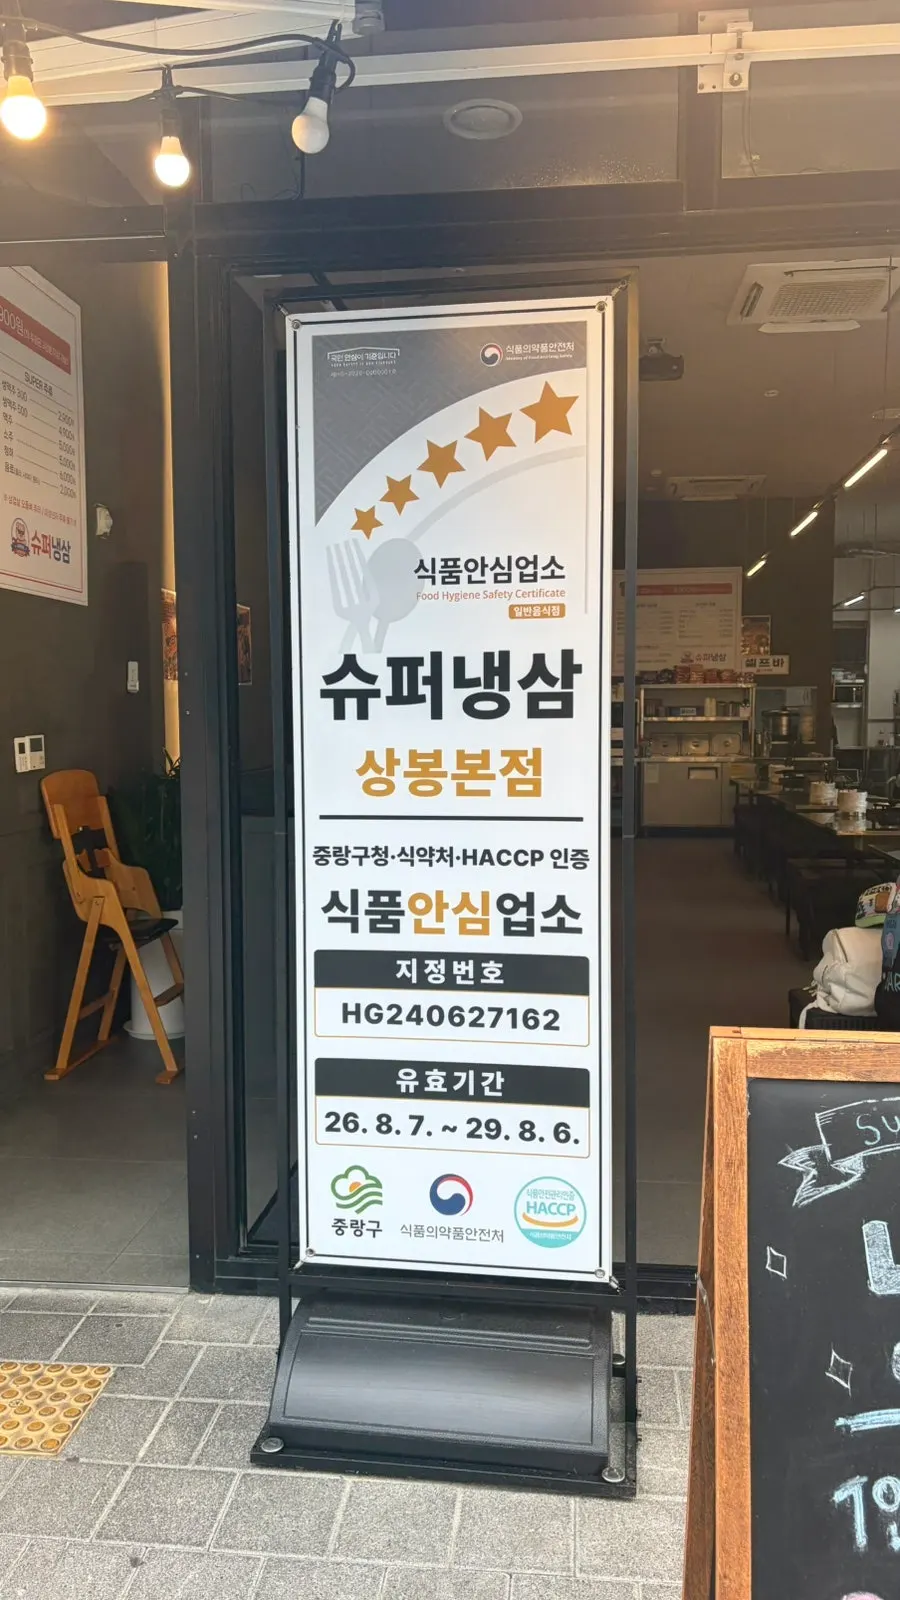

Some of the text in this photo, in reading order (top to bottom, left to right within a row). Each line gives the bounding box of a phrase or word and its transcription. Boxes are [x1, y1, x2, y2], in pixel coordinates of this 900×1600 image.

[505, 342, 575, 354] 식품의약품안전처
[31, 530, 71, 564] 슈퍼냉삼
[414, 554, 566, 586] 식품안심업소
[416, 588, 566, 602] Food Hygiene Safety Certificate
[513, 605, 561, 617] 일반음식점
[320, 649, 583, 720] 슈퍼냉삼
[356, 748, 542, 798] 상봉본점
[550, 848, 590, 870] 인증
[321, 888, 583, 938] 식품안심업소
[396, 958, 504, 985] 지정번호
[341, 1002, 561, 1031] HG240627162
[396, 1067, 505, 1097] 유효기간
[324, 1111, 368, 1134] 26.
[375, 1113, 401, 1135] 8.
[408, 1114, 433, 1137] 7.
[466, 1117, 510, 1141] 29.
[518, 1120, 545, 1143] 8.
[553, 1122, 580, 1145] 6.
[526, 1201, 577, 1216] HACCP
[331, 1218, 383, 1238] 중랑구
[400, 1223, 504, 1243] 식품의약품안전처
